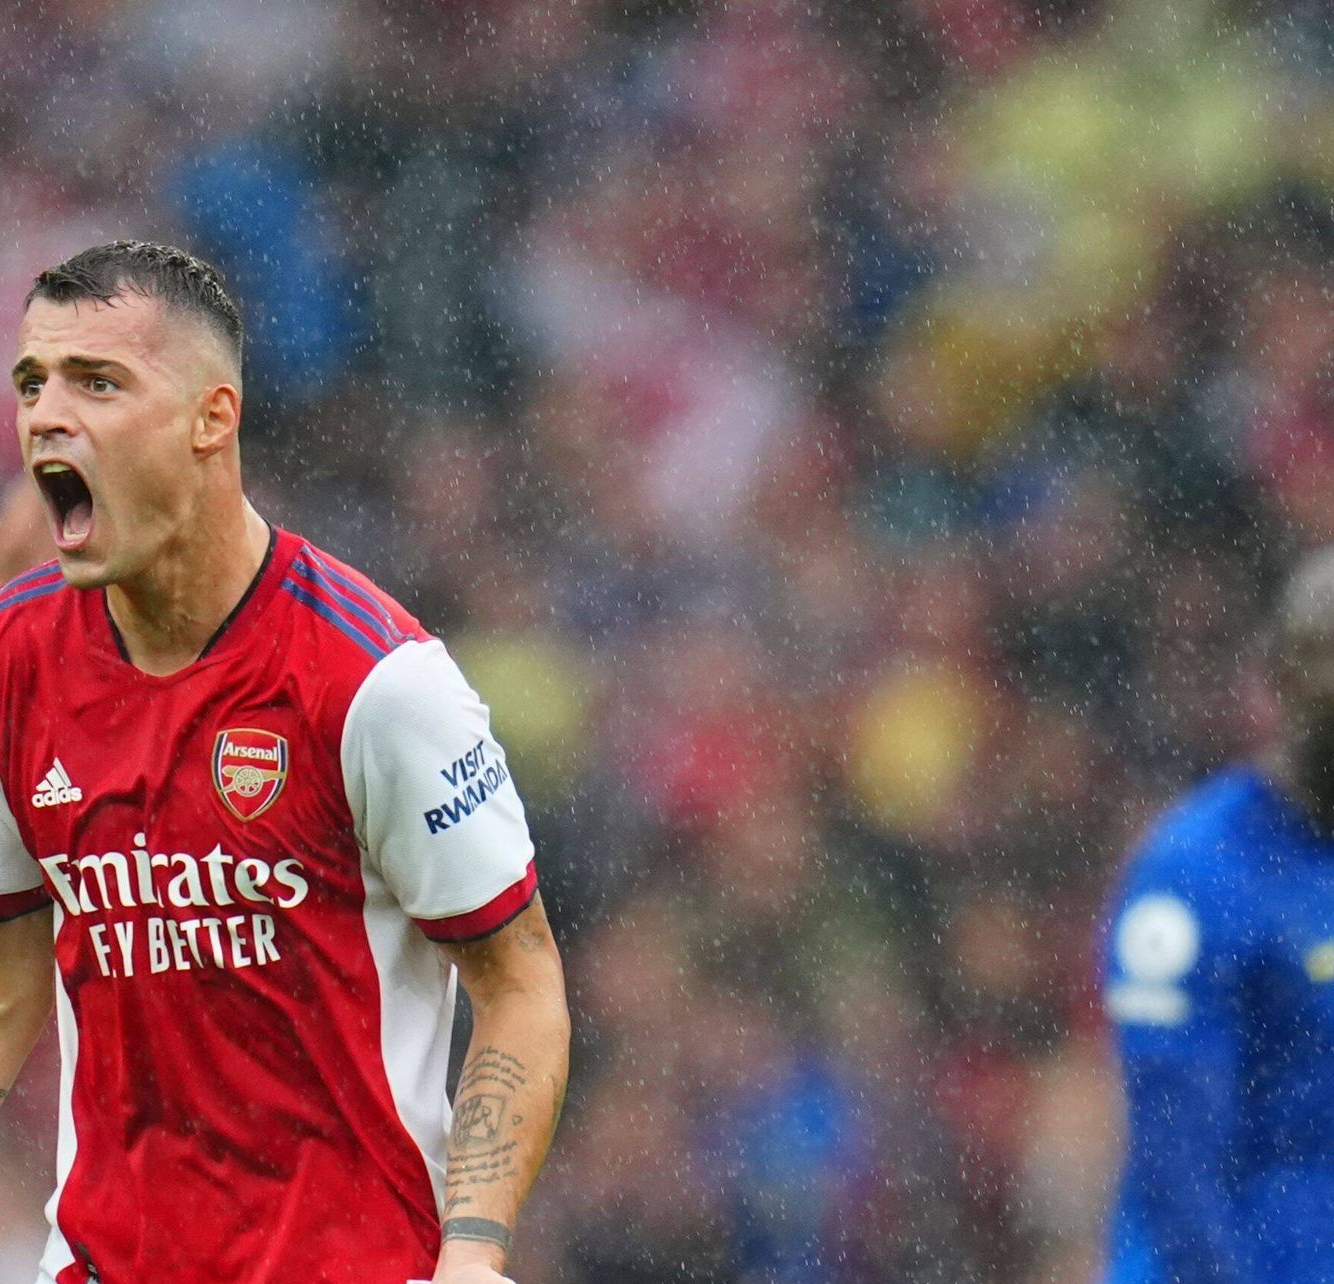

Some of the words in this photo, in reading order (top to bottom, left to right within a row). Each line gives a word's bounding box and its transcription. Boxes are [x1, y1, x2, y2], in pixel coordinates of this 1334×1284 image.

[223, 741, 279, 763] Arsenal
[440, 738, 486, 789] VISIT
[423, 758, 509, 836] RWANDA
[38, 831, 310, 917] Emirates
[88, 920, 135, 979] FY
[146, 912, 282, 975] BETTER
